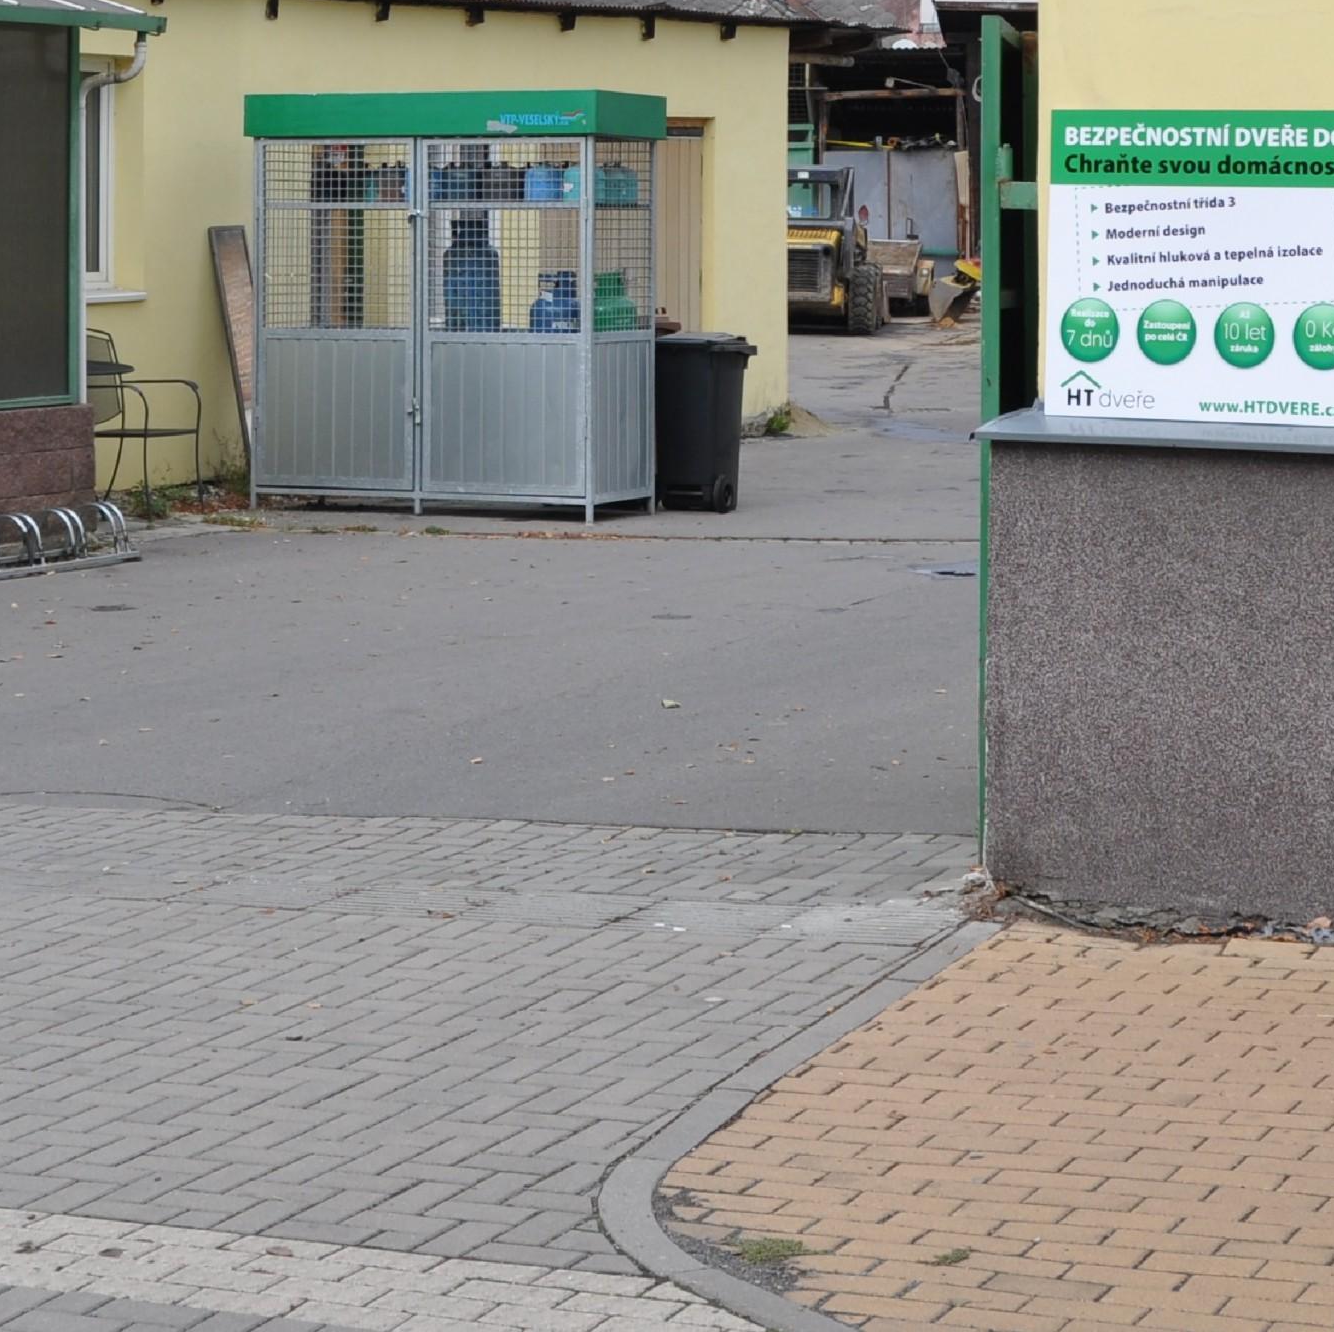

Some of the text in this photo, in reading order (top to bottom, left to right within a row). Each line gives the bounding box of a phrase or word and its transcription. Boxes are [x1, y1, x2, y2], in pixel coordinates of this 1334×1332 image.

[1064, 123, 1231, 147] BEZPEČNOSTNÍ
[1235, 124, 1308, 147] DVEŘE
[1064, 153, 1153, 174] Chraňte
[1158, 159, 1211, 174] svou
[1105, 197, 1236, 215] Bezpečnostní třída 3
[1106, 224, 1206, 239] Moderní design
[1107, 245, 1324, 266] Kvalitní hluková a tepelná izolace
[1107, 274, 1264, 292] Jednoduchá manipulace
[1143, 320, 1191, 331] Zastoupení
[1224, 323, 1267, 341] 10 let
[1305, 320, 1316, 338] 0
[1067, 329, 1114, 348] 7 dnů
[1144, 333, 1156, 342] po
[1230, 344, 1259, 353] záruka
[1067, 388, 1155, 409] HT dveře
